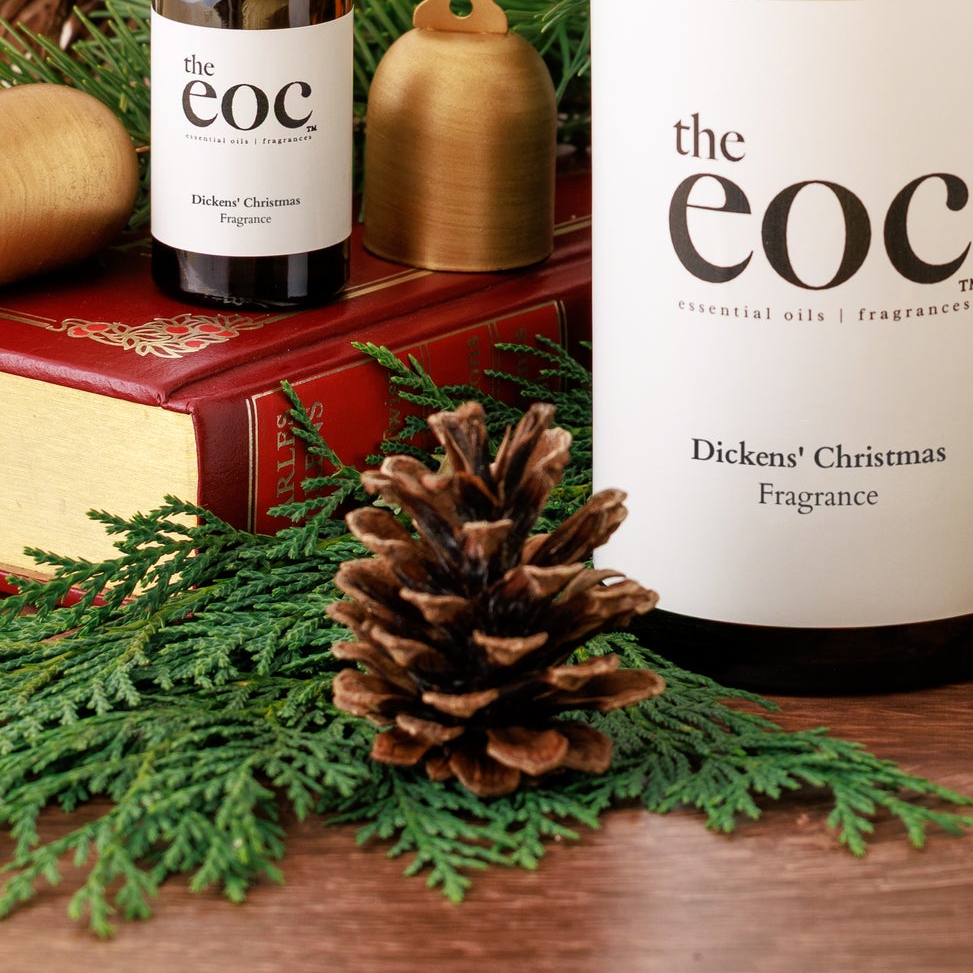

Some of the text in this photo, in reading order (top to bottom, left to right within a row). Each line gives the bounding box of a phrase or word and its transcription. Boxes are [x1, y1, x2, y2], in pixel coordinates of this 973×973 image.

[184, 54, 216, 77] the
[181, 79, 314, 132] eoc
[185, 133, 227, 145] essential
[230, 137, 249, 145] oils
[262, 134, 313, 146] fragrances
[673, 112, 747, 163] the
[191, 194, 301, 208] Dickens' Christmas
[220, 213, 272, 228] Fragrance
[668, 172, 973, 292] eoc
[678, 300, 772, 321] essential
[783, 309, 826, 323] oils
[857, 298, 971, 323] fragrances
[690, 437, 948, 469] Dickens' Christmas
[757, 482, 880, 516] Fragrance
